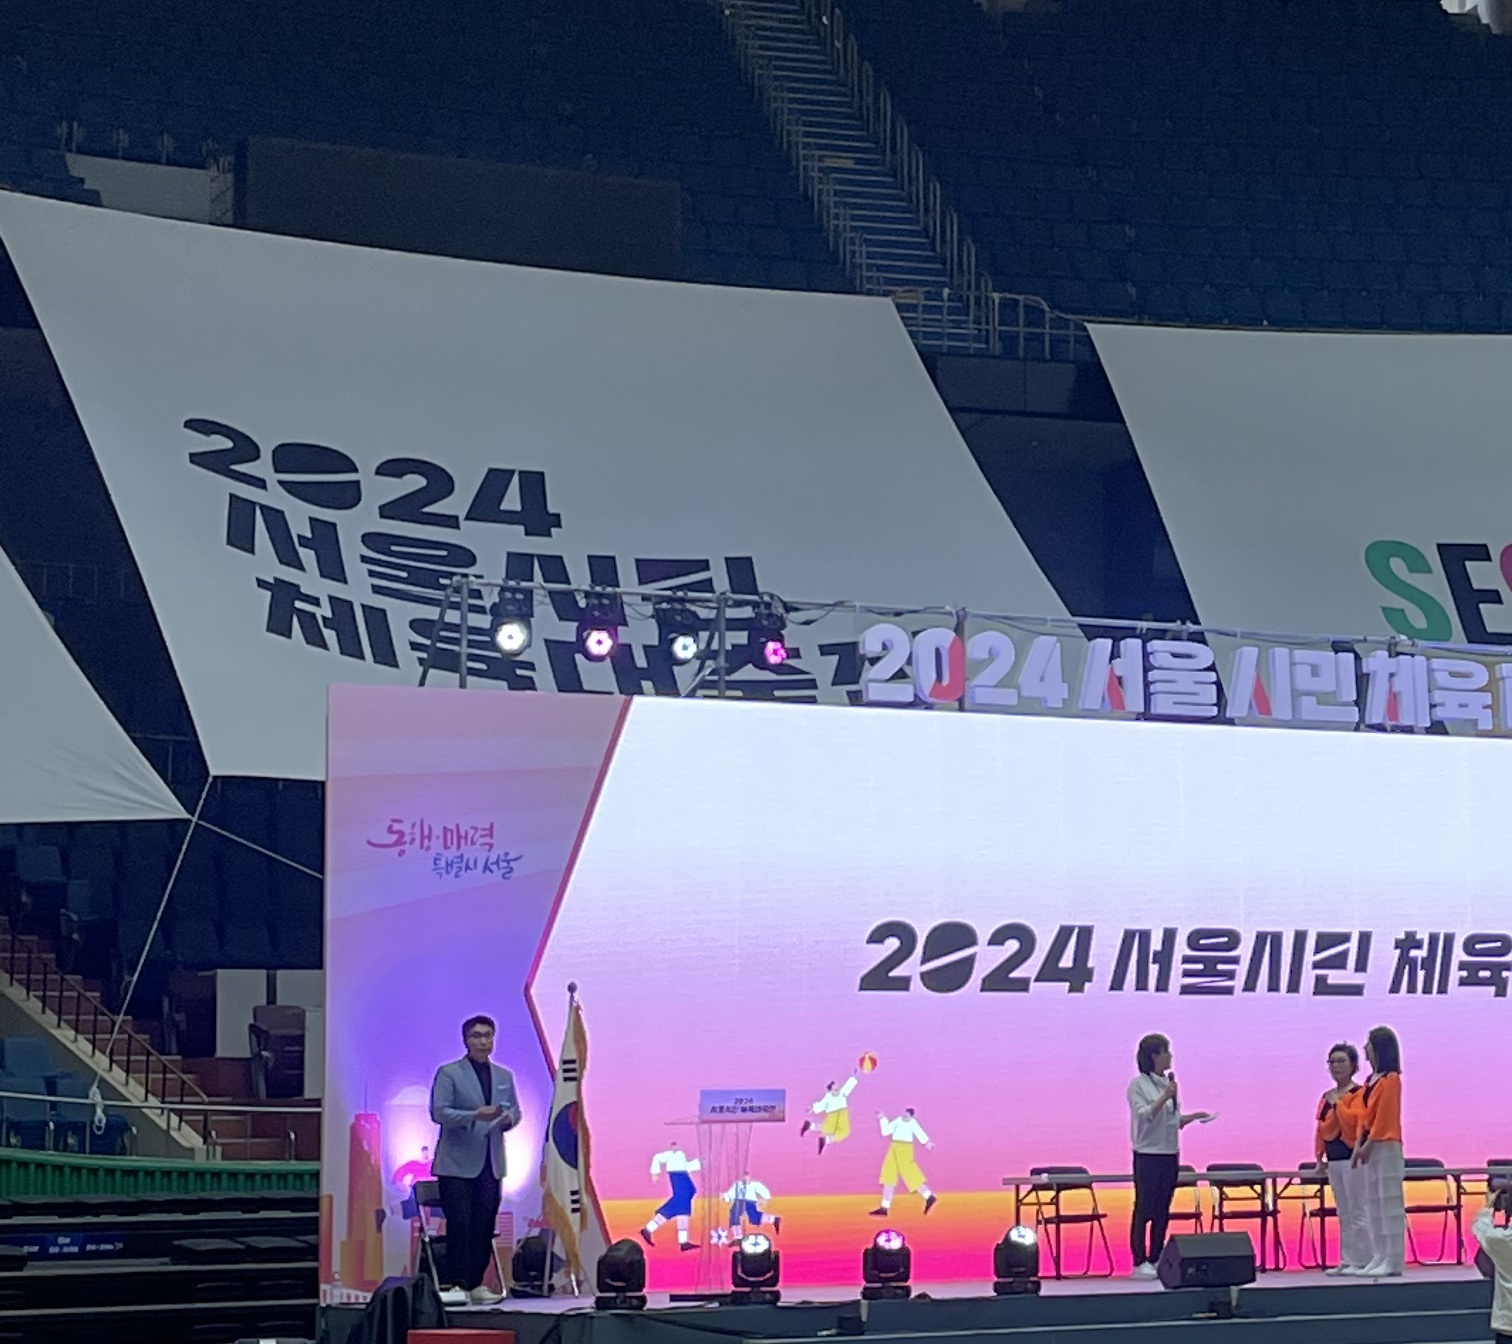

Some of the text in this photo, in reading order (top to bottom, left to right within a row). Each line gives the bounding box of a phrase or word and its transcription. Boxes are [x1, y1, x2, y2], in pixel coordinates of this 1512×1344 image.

[183, 418, 562, 538] 2024
[860, 623, 1069, 708] 2024
[482, 852, 524, 880] 서울
[857, 920, 1095, 994] 2024
[1107, 927, 1373, 997] 서울시민
